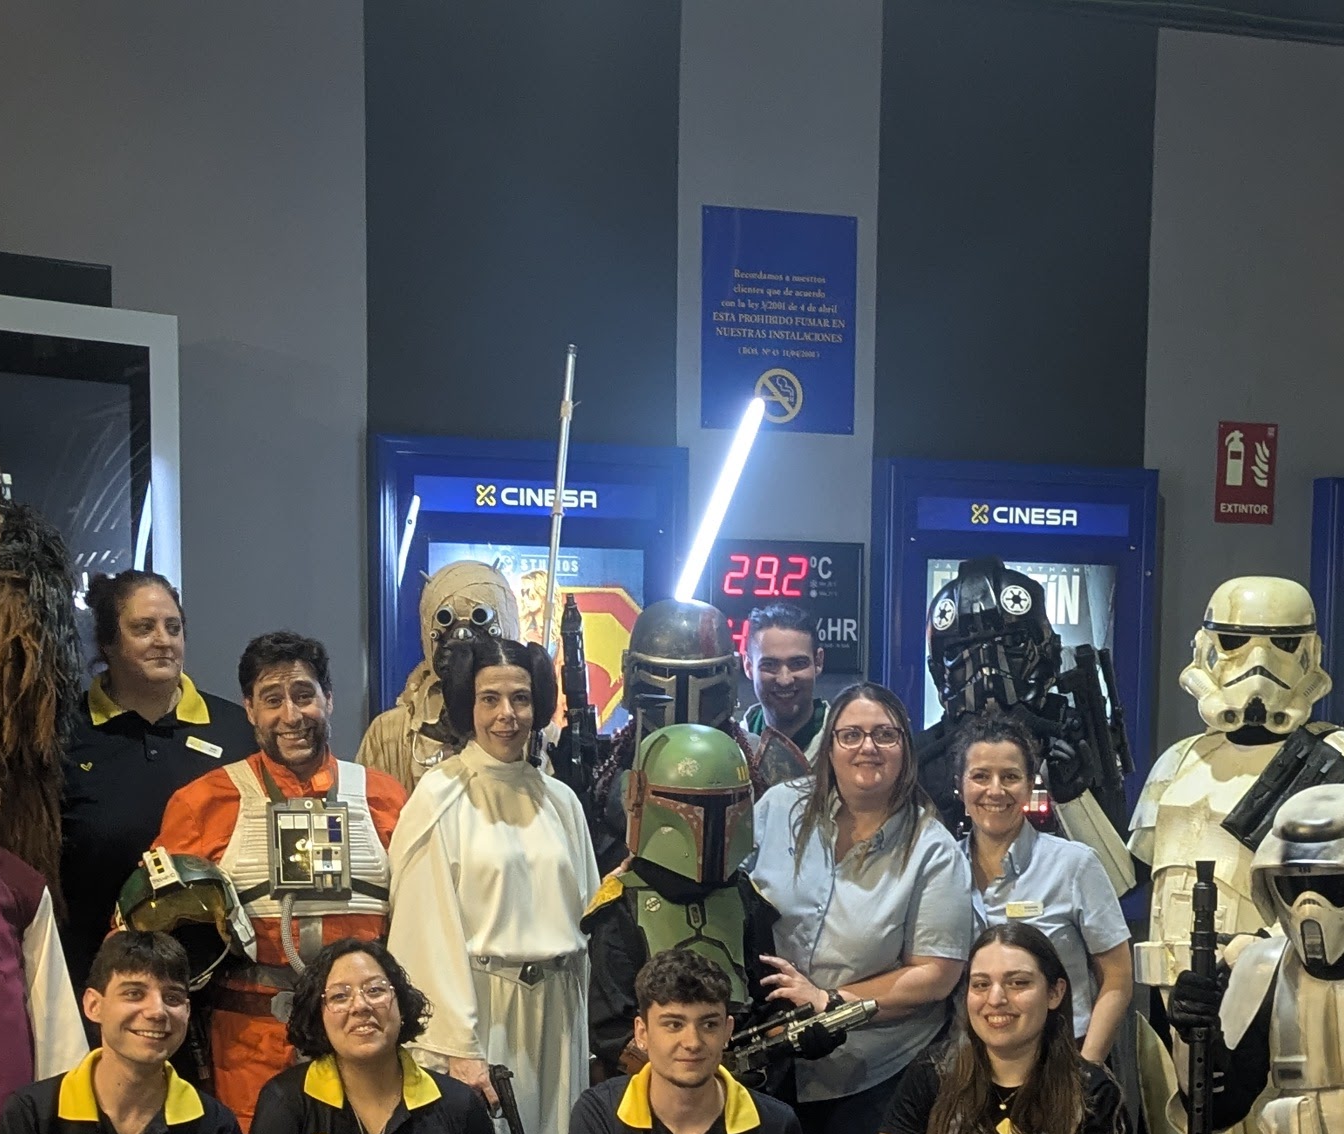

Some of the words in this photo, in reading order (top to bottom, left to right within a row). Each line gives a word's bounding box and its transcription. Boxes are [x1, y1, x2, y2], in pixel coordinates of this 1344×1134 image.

[734, 269, 783, 281] Recordamos
[792, 275, 826, 284] nuestros
[733, 284, 764, 294] clientes
[766, 287, 781, 296] que
[783, 287, 793, 296] de
[795, 288, 826, 298] acuerdo
[721, 300, 736, 308] con
[737, 299, 746, 308] la
[748, 299, 759, 310] ley
[818, 304, 838, 314] abril
[738, 313, 793, 325] PROHIBIDO
[795, 316, 830, 328] FUMAR
[832, 318, 845, 329] EN
[716, 327, 767, 339] NUESTRAS
[769, 329, 843, 343] INSTALACIONES
[500, 487, 597, 508] CINESA
[993, 506, 1077, 526] CINESA
[1220, 502, 1268, 515] EXTINTOR
[520, 558, 579, 573] STUIOS
[723, 555, 809, 596] 29.2
